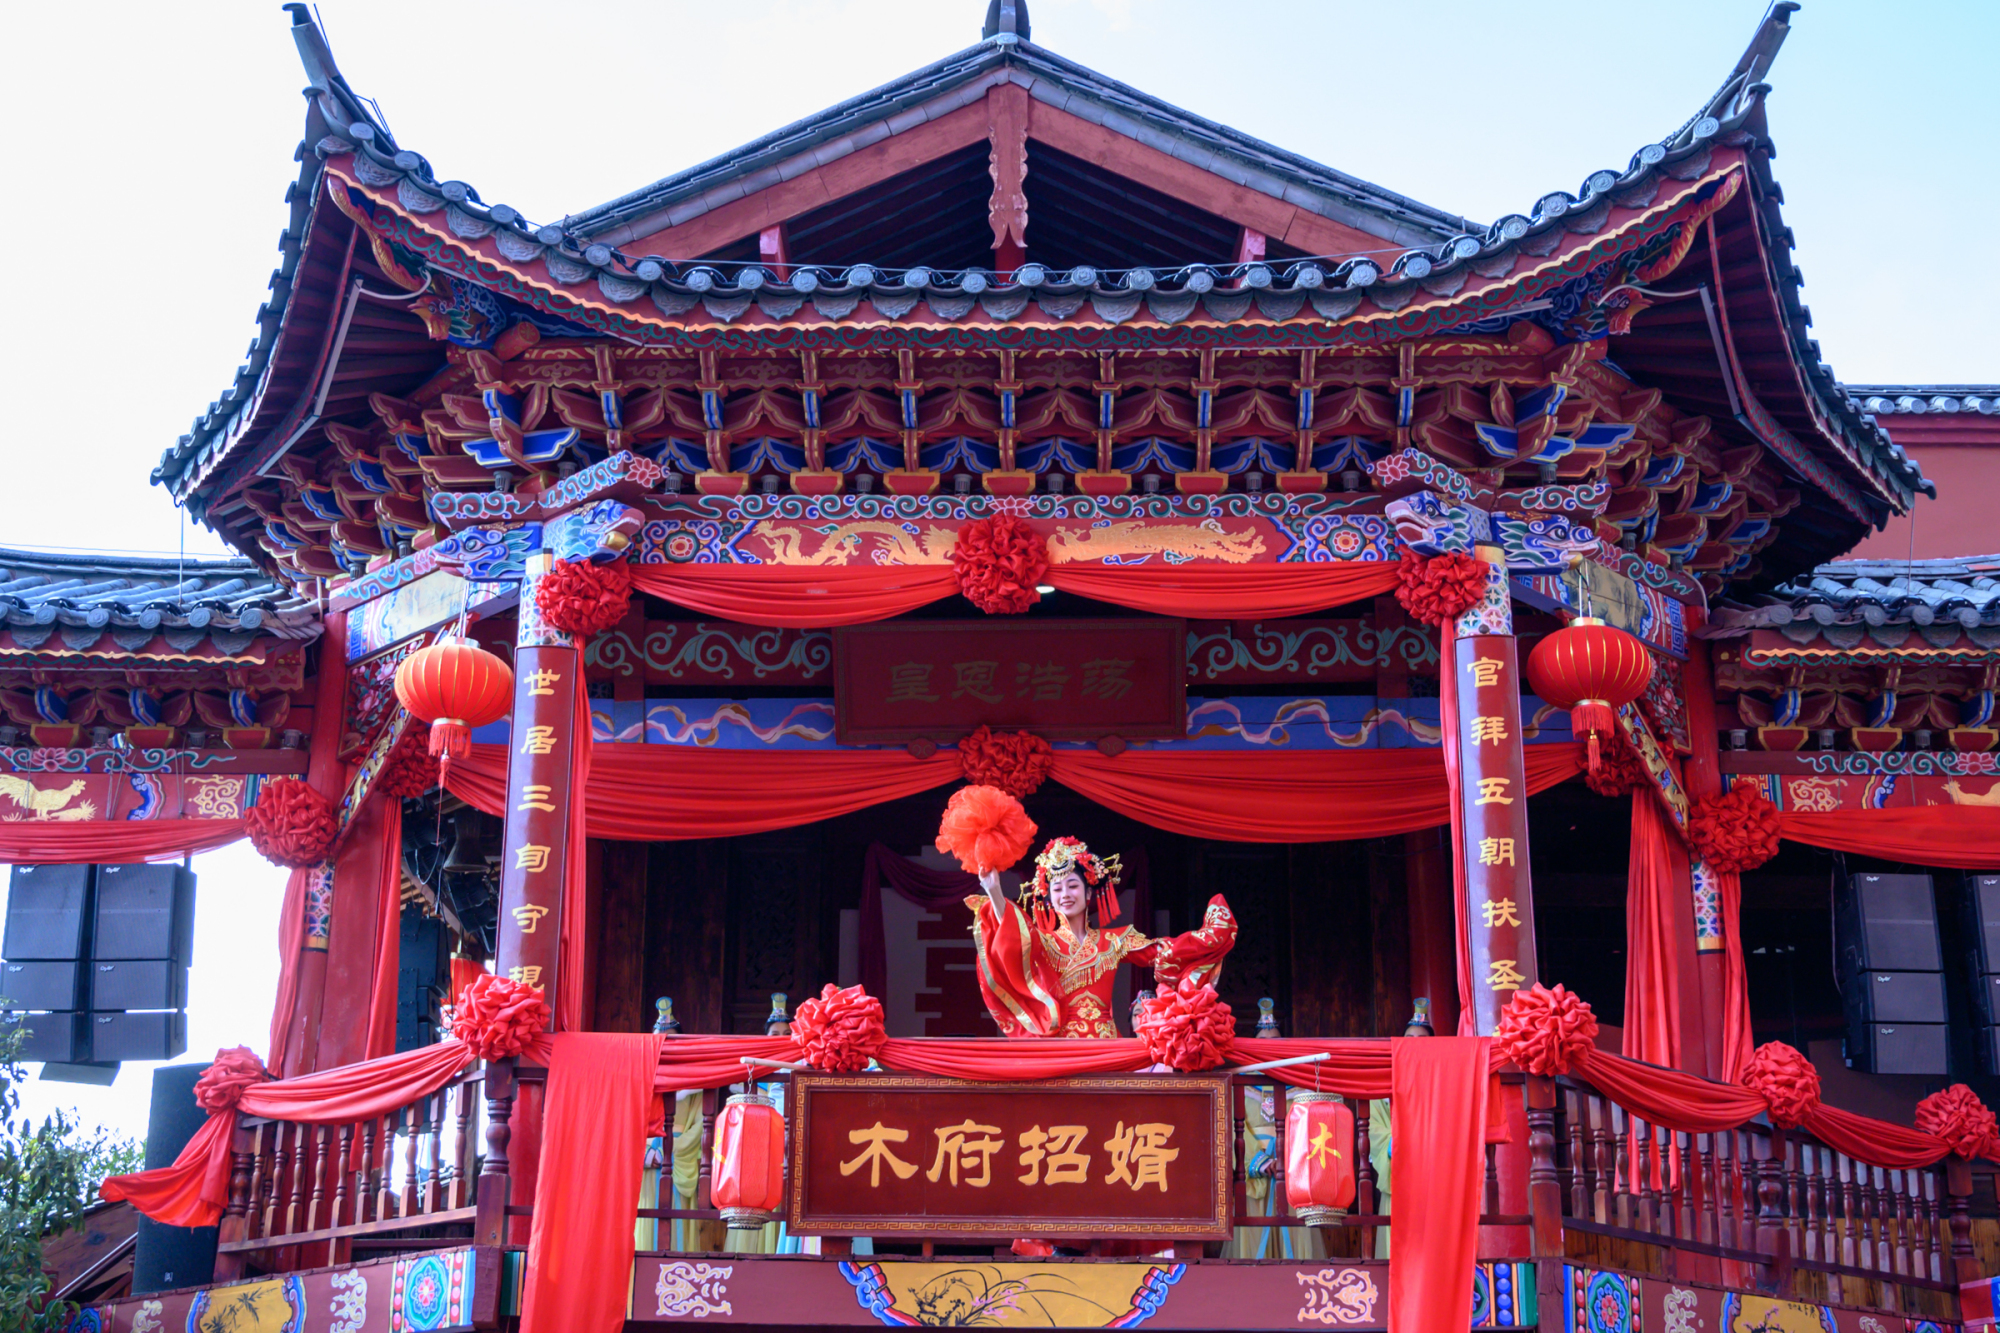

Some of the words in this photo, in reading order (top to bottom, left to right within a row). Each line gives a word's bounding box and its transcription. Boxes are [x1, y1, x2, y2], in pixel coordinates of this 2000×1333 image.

[884, 656, 1136, 705] 皇恩浩荡
[1466, 656, 1527, 1037] 官拜五朝扶圣
[839, 1118, 1181, 1193] 木府招婿
[1306, 1122, 1342, 1170] 木
